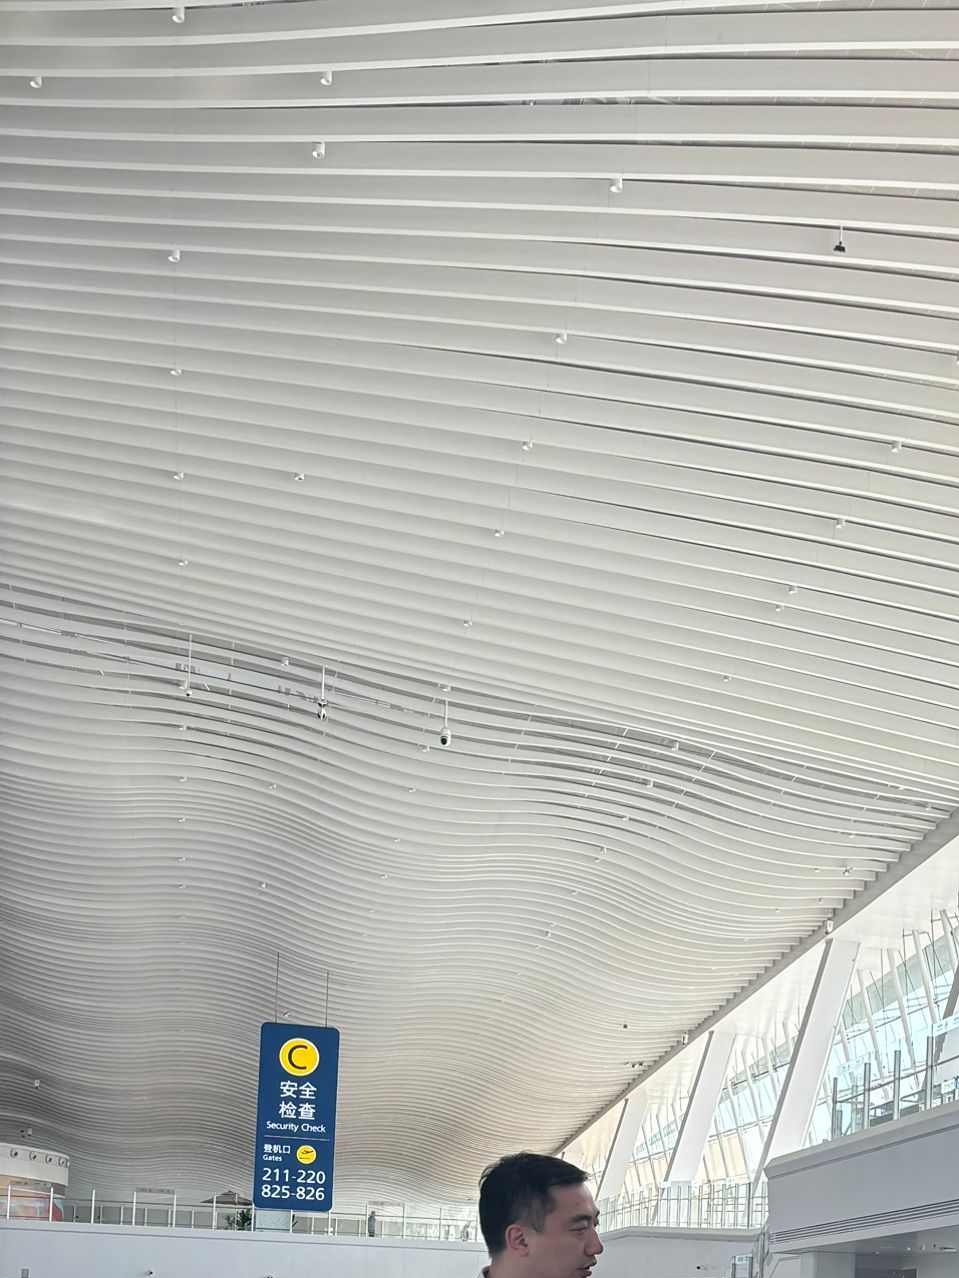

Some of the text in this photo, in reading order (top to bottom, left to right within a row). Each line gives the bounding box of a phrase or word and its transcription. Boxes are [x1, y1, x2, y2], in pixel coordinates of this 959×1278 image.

[287, 1044, 308, 1070] C
[279, 1080, 318, 1099] 安全
[278, 1100, 317, 1120] 检查
[266, 1120, 326, 1133] Security Check
[263, 1143, 291, 1154] 登机口
[262, 1154, 283, 1162] Gates
[262, 1167, 326, 1184] 211-220
[261, 1184, 325, 1201] 825-826
